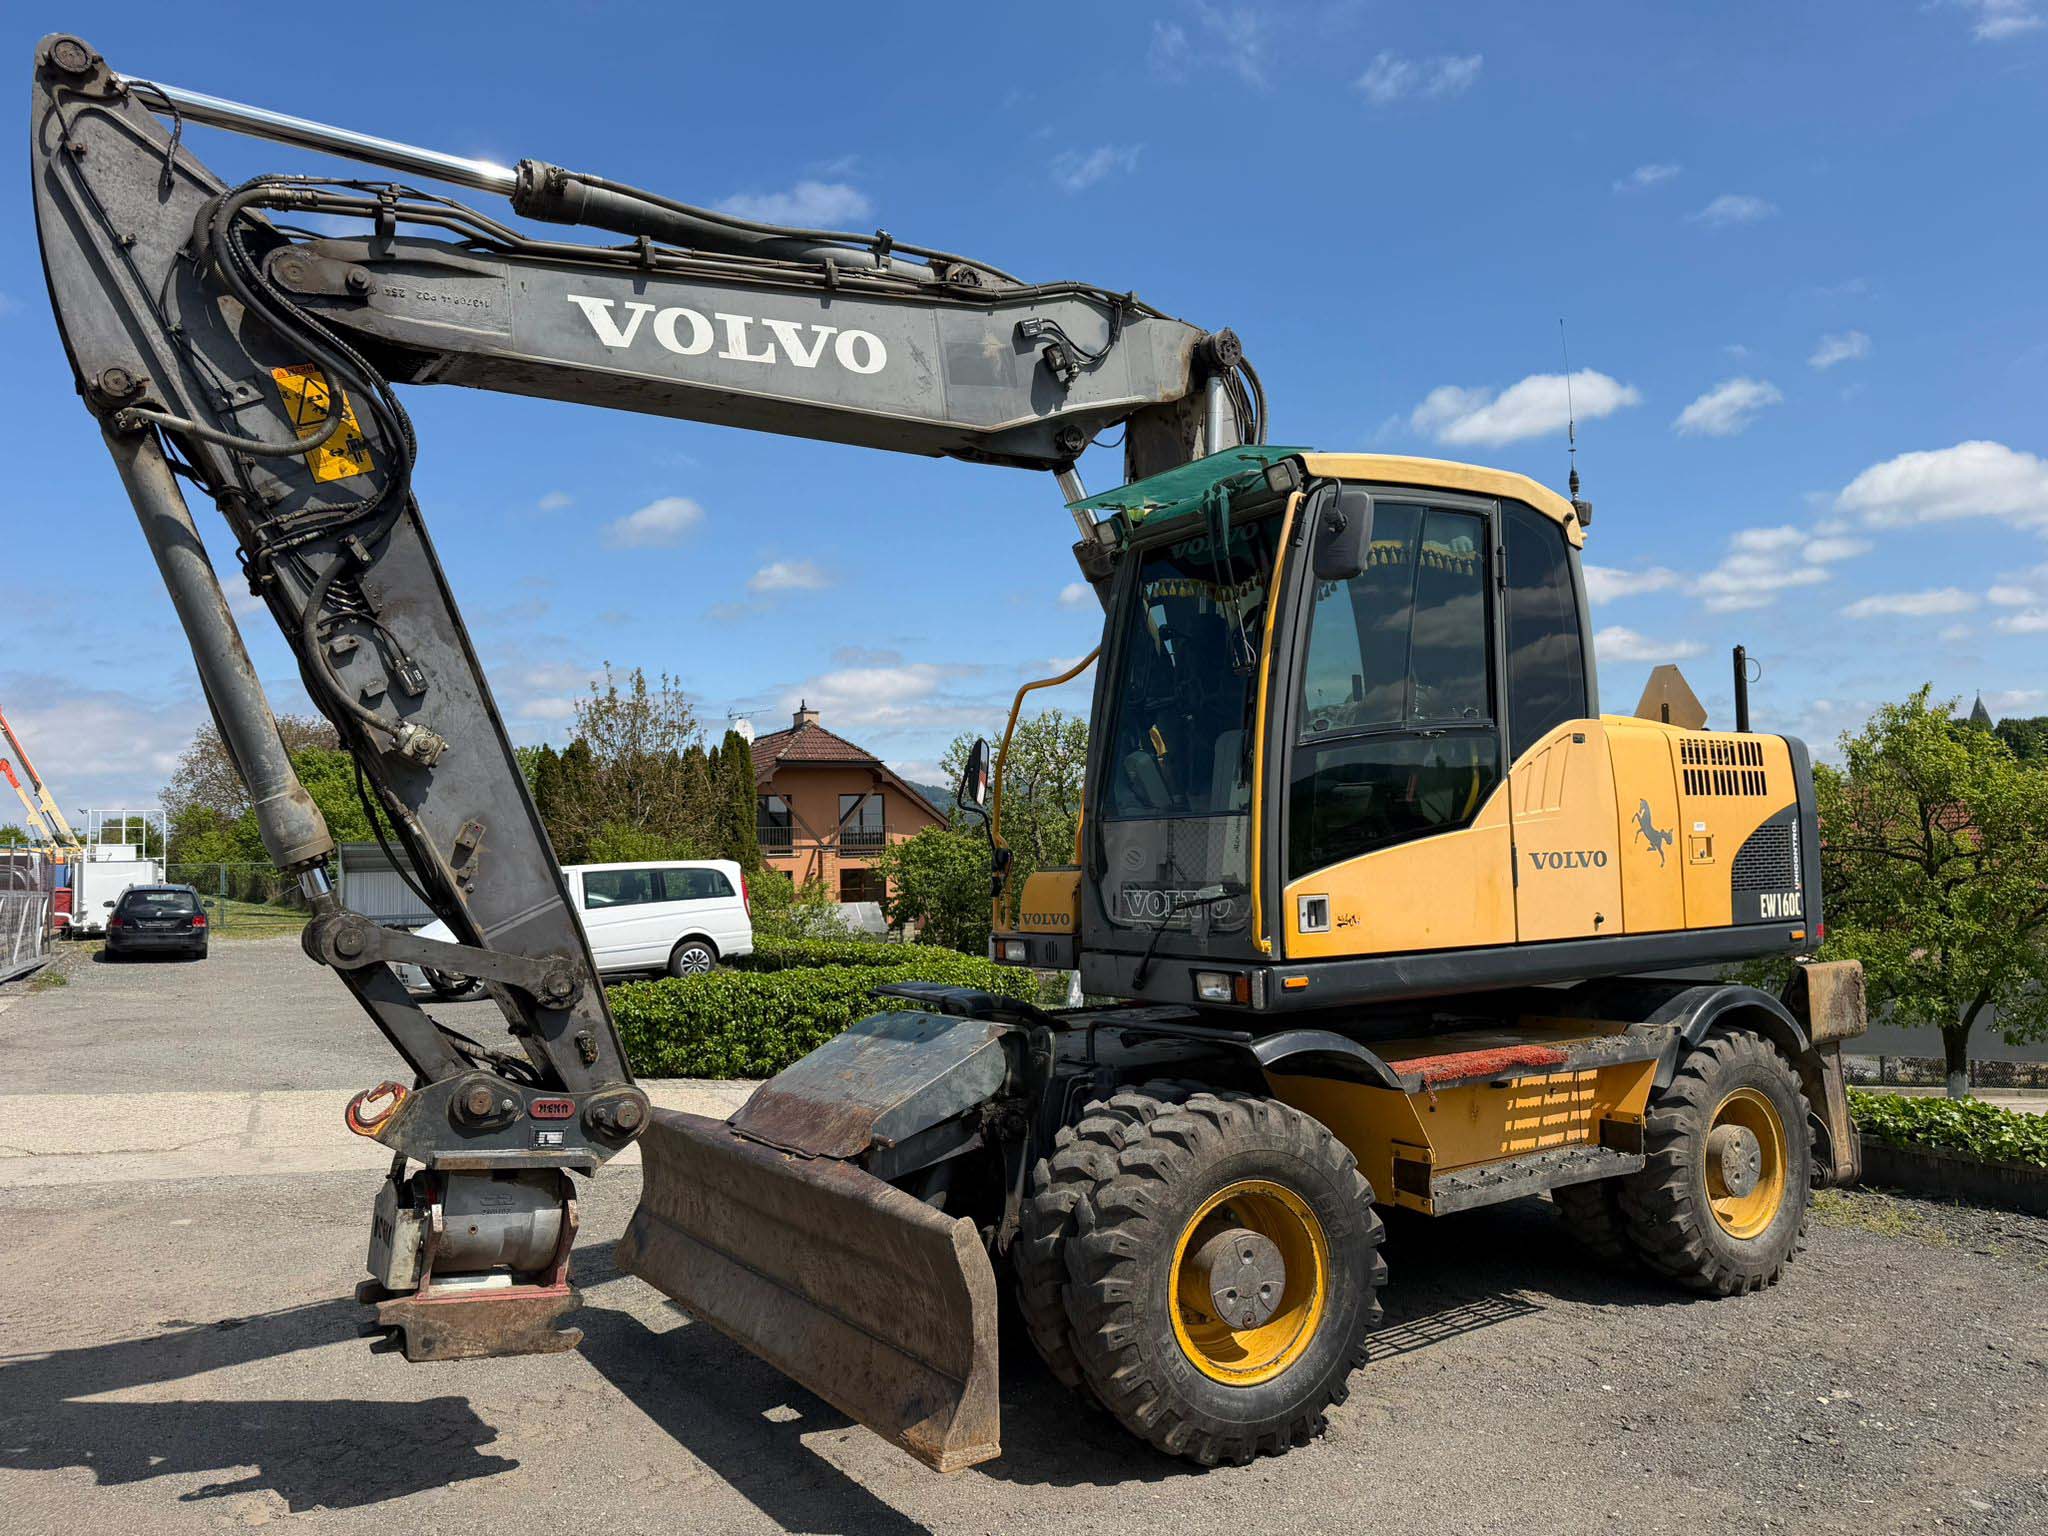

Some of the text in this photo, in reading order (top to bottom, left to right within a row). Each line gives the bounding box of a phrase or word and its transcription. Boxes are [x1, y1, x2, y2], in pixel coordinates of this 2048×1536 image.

[567, 294, 888, 375] VOLVO
[1528, 850, 1608, 870] VOLVO
[1123, 890, 1231, 919] VOLVO
[1760, 892, 1801, 918] EW160C
[1022, 913, 1070, 926] VOLVO
